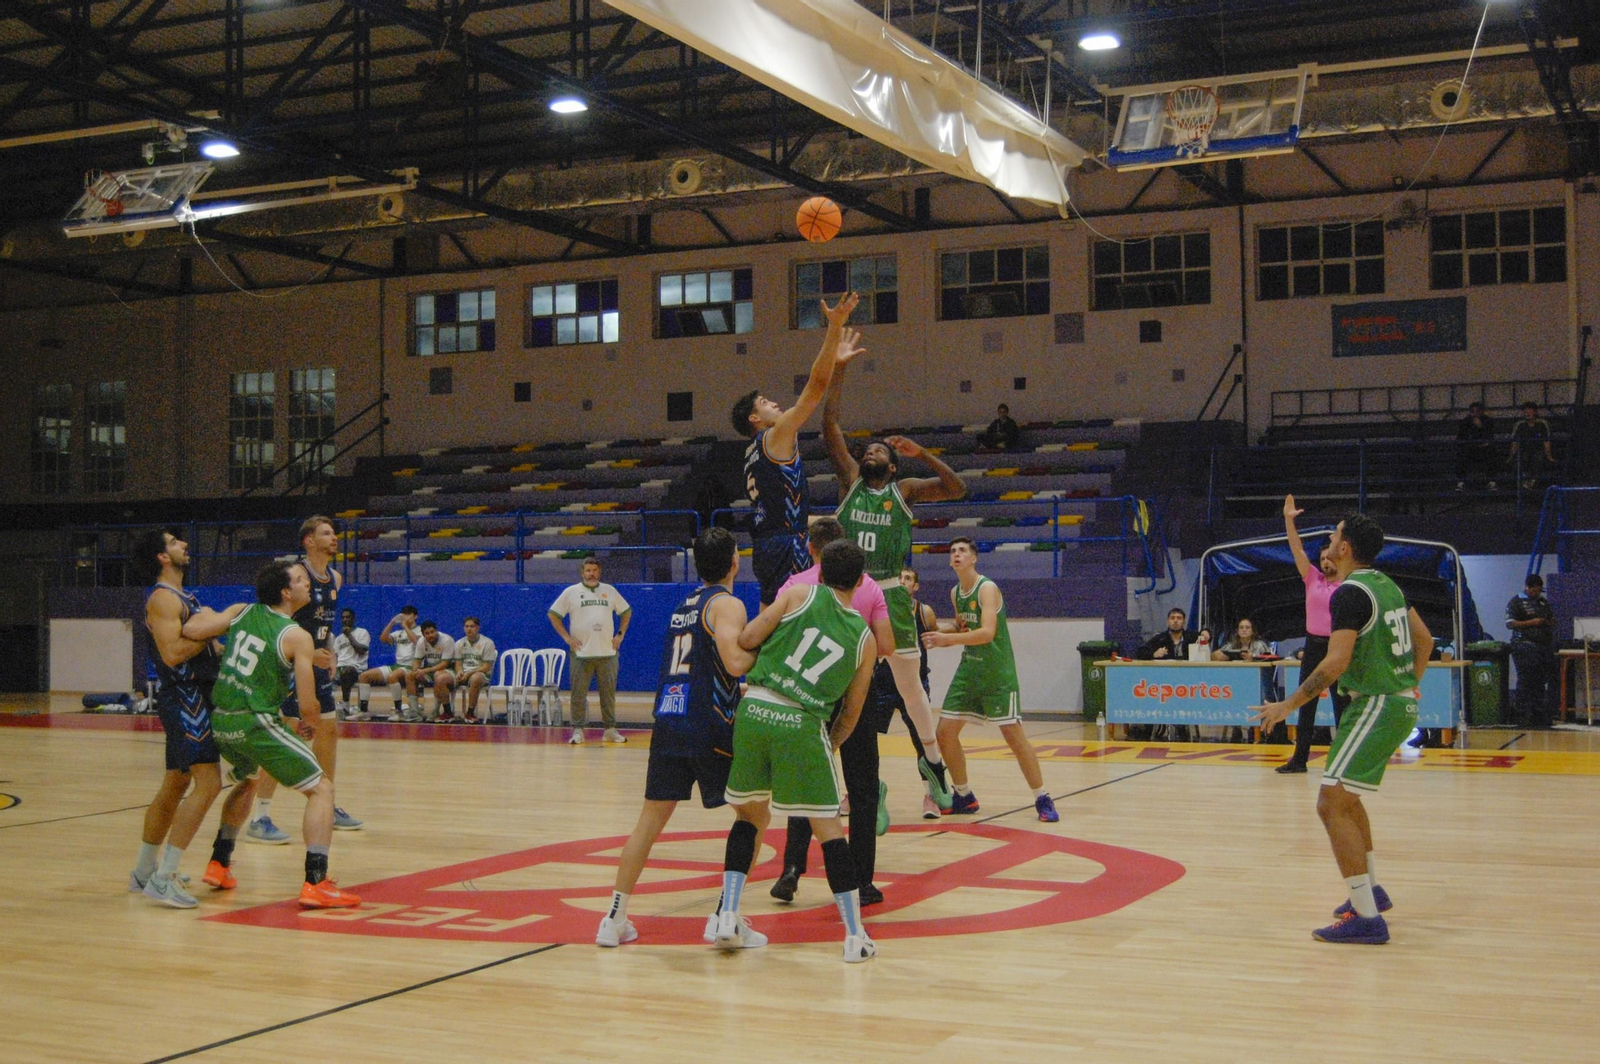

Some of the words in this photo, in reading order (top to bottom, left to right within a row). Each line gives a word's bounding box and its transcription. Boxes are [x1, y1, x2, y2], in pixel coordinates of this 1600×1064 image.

[857, 531, 877, 552] 10
[1384, 607, 1412, 656] 30
[226, 629, 267, 677] 15
[669, 632, 693, 676] 12
[784, 627, 845, 685] 17
[1132, 679, 1233, 703] deportes
[747, 703, 803, 724] OKEYMAS
[297, 901, 553, 933] FEB
